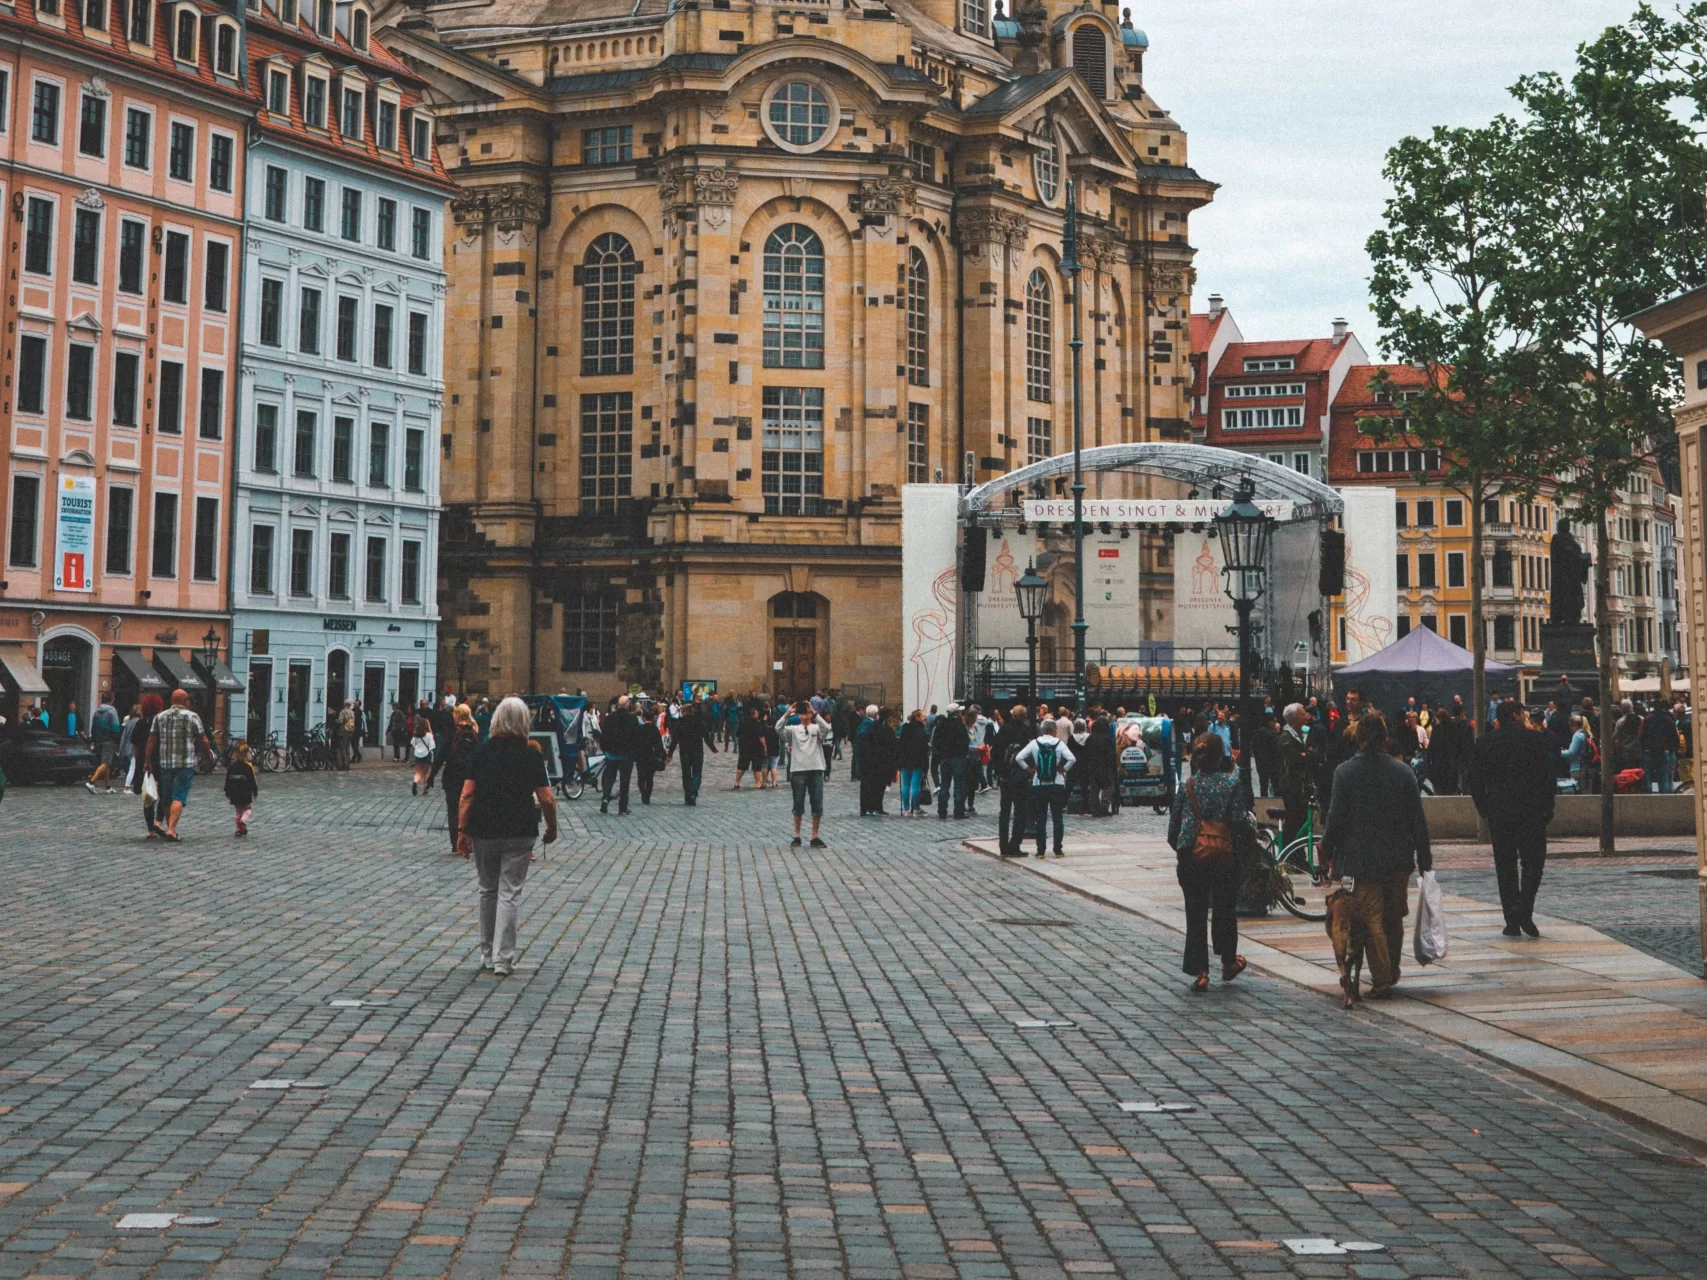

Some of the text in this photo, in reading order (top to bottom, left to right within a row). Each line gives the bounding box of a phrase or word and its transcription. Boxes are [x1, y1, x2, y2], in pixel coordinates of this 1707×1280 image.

[4, 241, 18, 415] PASSAGE
[145, 271, 158, 435] PASSAGE
[62, 496, 92, 508] TOURIST
[61, 507, 92, 515] INFORMATION
[1034, 504, 1110, 517] DRESDEN
[1118, 505, 1167, 517] SINGT
[1175, 505, 1187, 516] &
[323, 618, 357, 631] MEISSEN
[43, 650, 71, 662] ASSAGE
